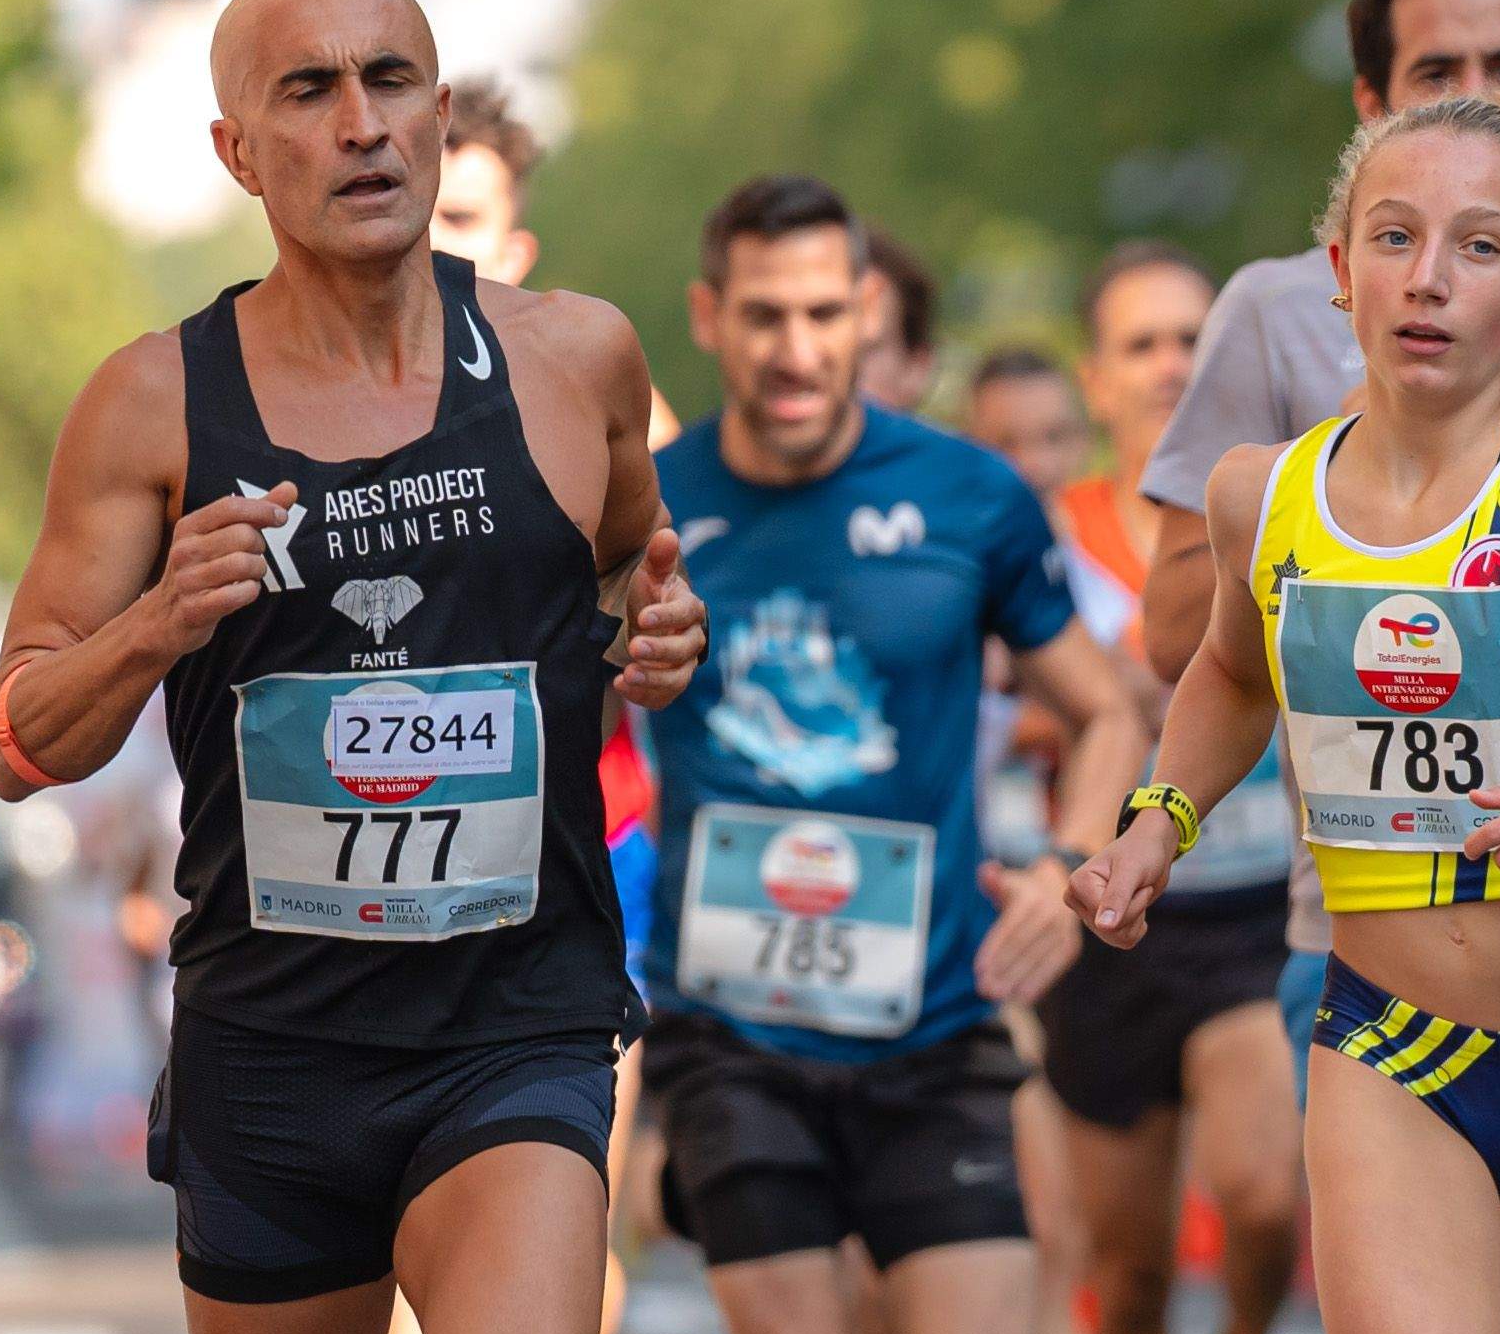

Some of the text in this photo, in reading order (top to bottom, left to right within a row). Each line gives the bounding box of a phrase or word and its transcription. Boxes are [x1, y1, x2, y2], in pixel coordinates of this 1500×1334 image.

[325, 468, 485, 522] ARES PROJECT
[327, 506, 494, 559] RUNNERS
[351, 647, 409, 668] FANTÉ
[1377, 653, 1441, 666] TotalEnergies
[1393, 675, 1424, 685] MILLA
[1372, 685, 1449, 695] INTERNACIONAL
[1385, 695, 1440, 704] DE MADRID
[346, 712, 497, 754] 27844
[1356, 720, 1484, 794] 783
[358, 783, 420, 794] DE MADRID
[1320, 812, 1375, 828] MADRID
[1417, 813, 1450, 823] MILLA
[323, 808, 462, 883] 777
[281, 898, 342, 917] MADRID
[386, 904, 425, 913] MILLA
[386, 914, 431, 924] URBANA
[752, 916, 857, 982] 785
